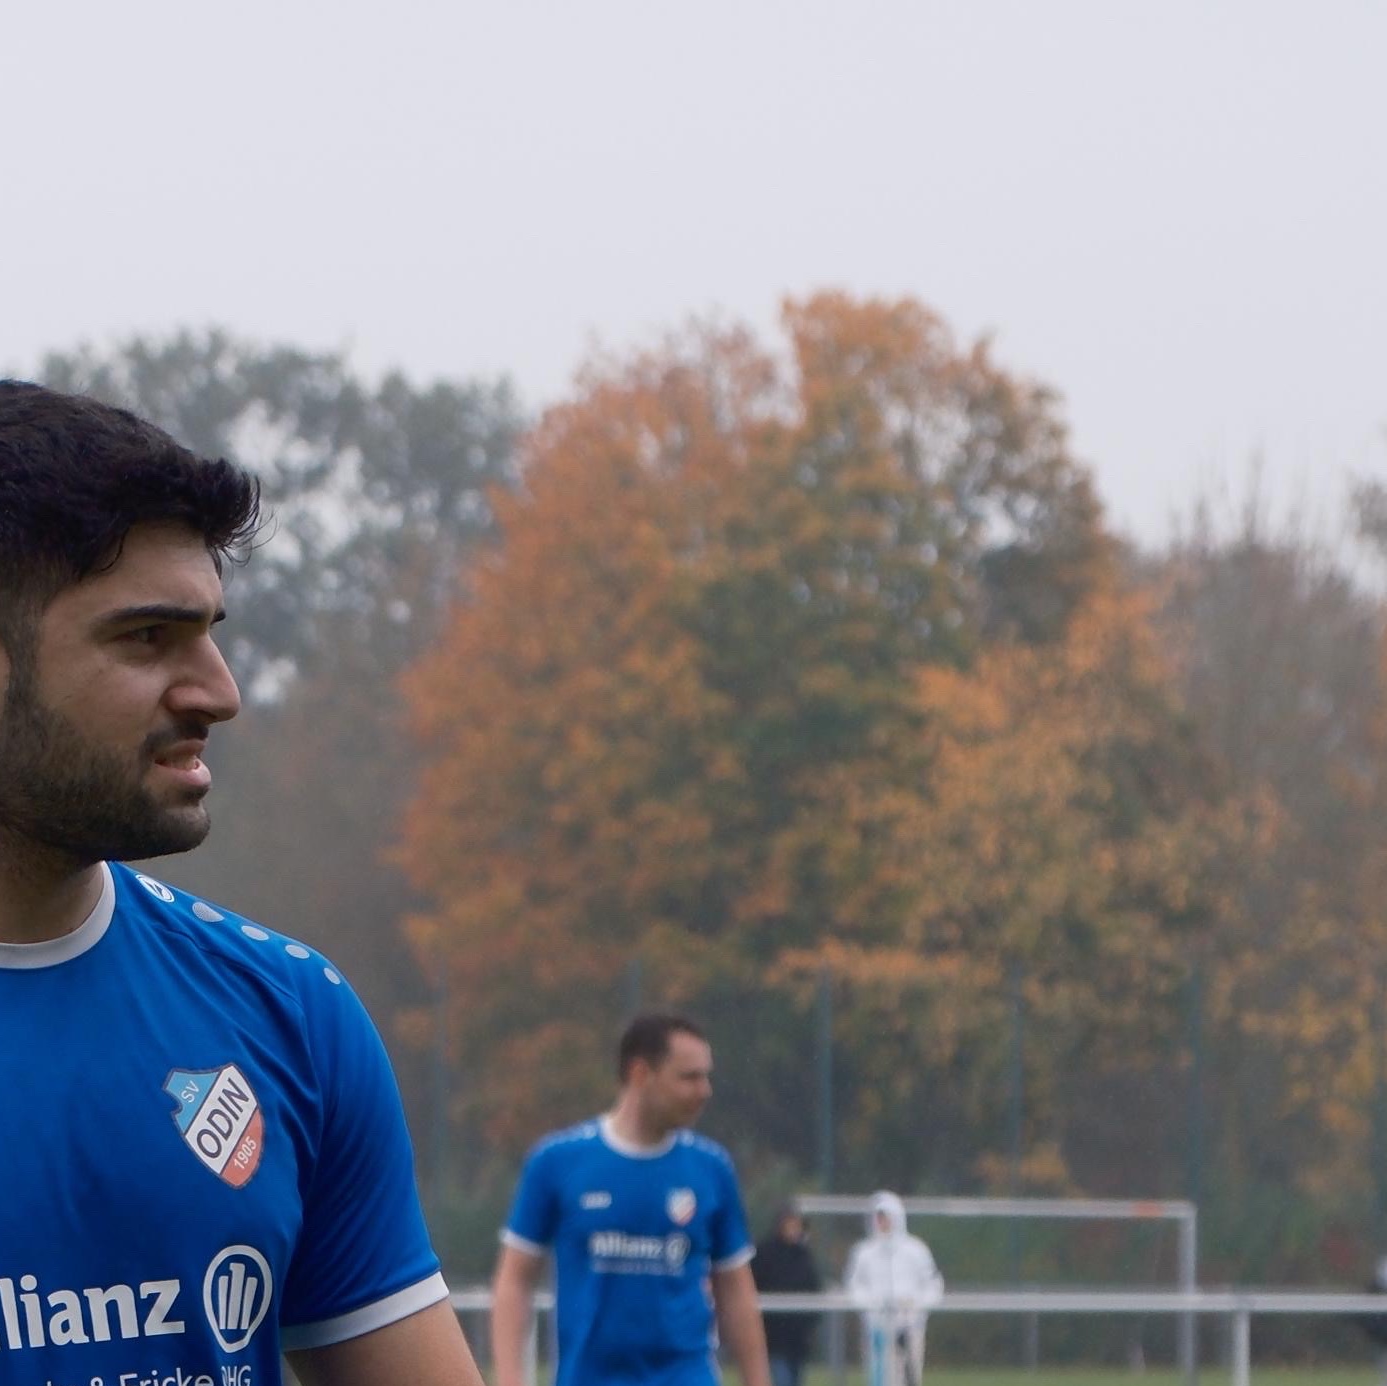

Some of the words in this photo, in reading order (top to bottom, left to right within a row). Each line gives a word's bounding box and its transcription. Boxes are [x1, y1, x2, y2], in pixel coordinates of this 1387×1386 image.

[181, 1080, 200, 1103] SV
[196, 1077, 250, 1159] ODIN
[234, 1136, 257, 1170] 1905
